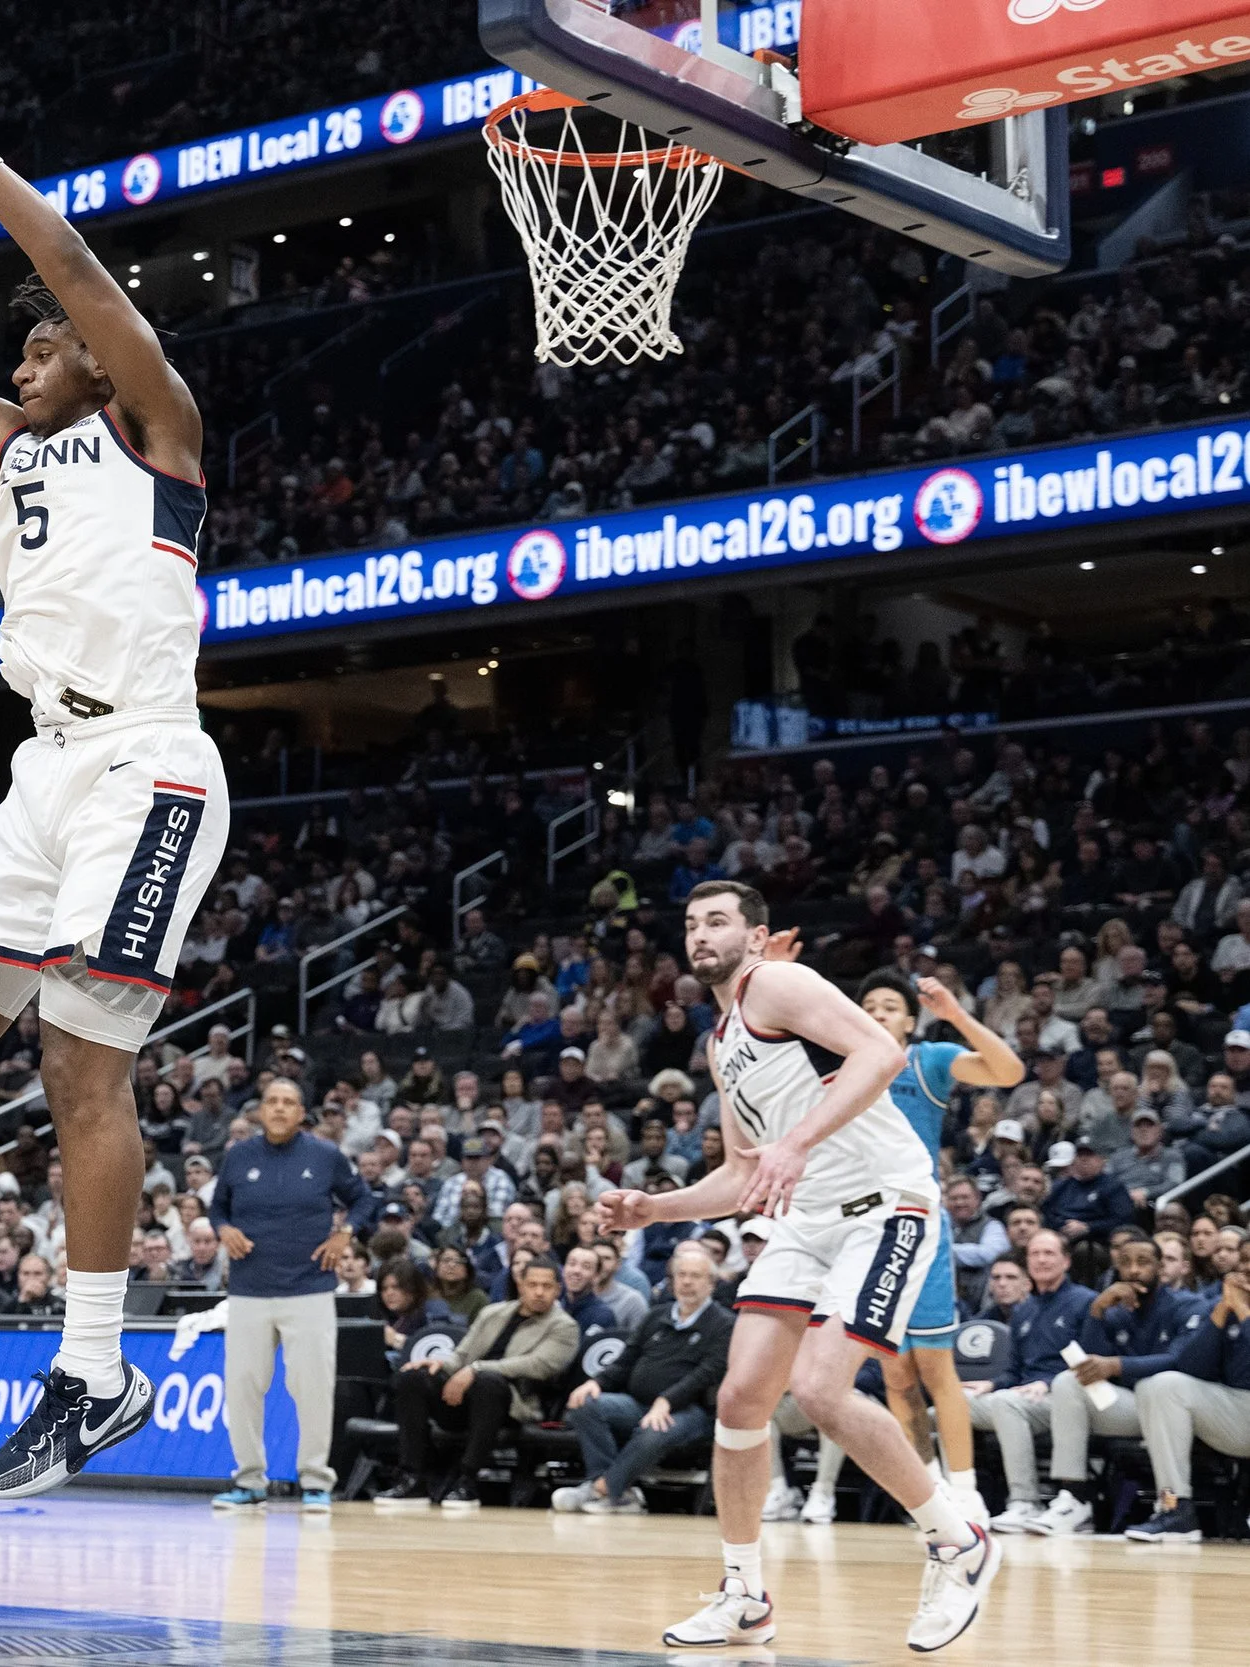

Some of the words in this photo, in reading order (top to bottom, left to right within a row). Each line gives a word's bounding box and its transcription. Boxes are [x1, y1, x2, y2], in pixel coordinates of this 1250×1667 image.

[740, 3, 800, 54] IBE
[1057, 35, 1250, 94] State
[179, 137, 242, 187] IBEW
[249, 118, 318, 171] Local
[326, 108, 361, 153] 26
[73, 170, 105, 213] 26
[11, 480, 49, 550] 5
[991, 428, 1250, 526] ibewlocal2
[576, 495, 902, 580] ibewlocal26.org
[217, 551, 498, 629] ibewlocal26.org
[121, 805, 190, 960] HUSKIES
[865, 1218, 918, 1328] HUSKIES
[153, 1371, 230, 1433] QQ
